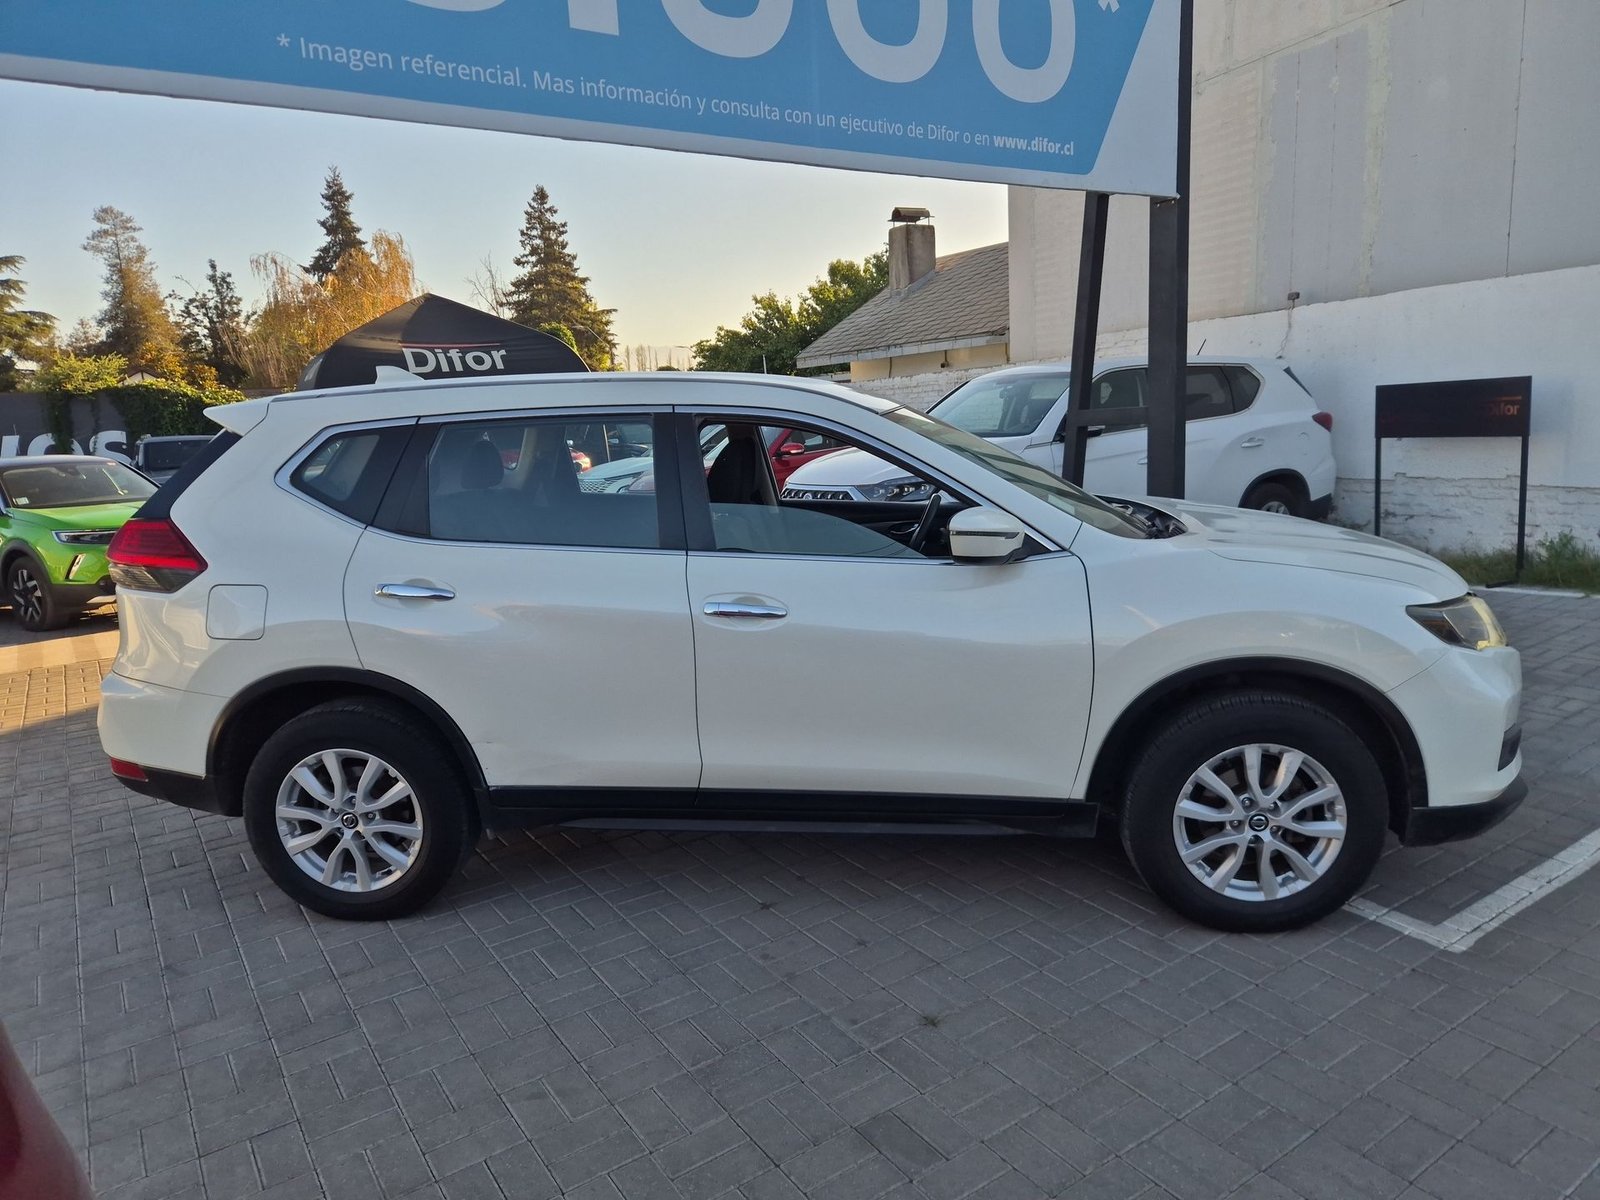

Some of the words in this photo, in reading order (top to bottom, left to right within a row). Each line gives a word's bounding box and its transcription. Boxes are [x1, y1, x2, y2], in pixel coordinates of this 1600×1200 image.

[300, 36, 393, 72] Imagen
[400, 53, 527, 88] referencial.
[533, 70, 575, 94] Mas
[580, 76, 692, 109] información
[696, 96, 706, 116] y
[711, 100, 780, 121] consulta
[784, 109, 812, 125] con
[816, 113, 836, 128] un
[839, 116, 904, 136] ejecutivo
[907, 121, 924, 139] de
[927, 123, 960, 143] Difor
[963, 132, 971, 144] o
[974, 133, 990, 146] en
[993, 135, 1075, 156] www.difor.cl
[402, 347, 506, 374] Difor
